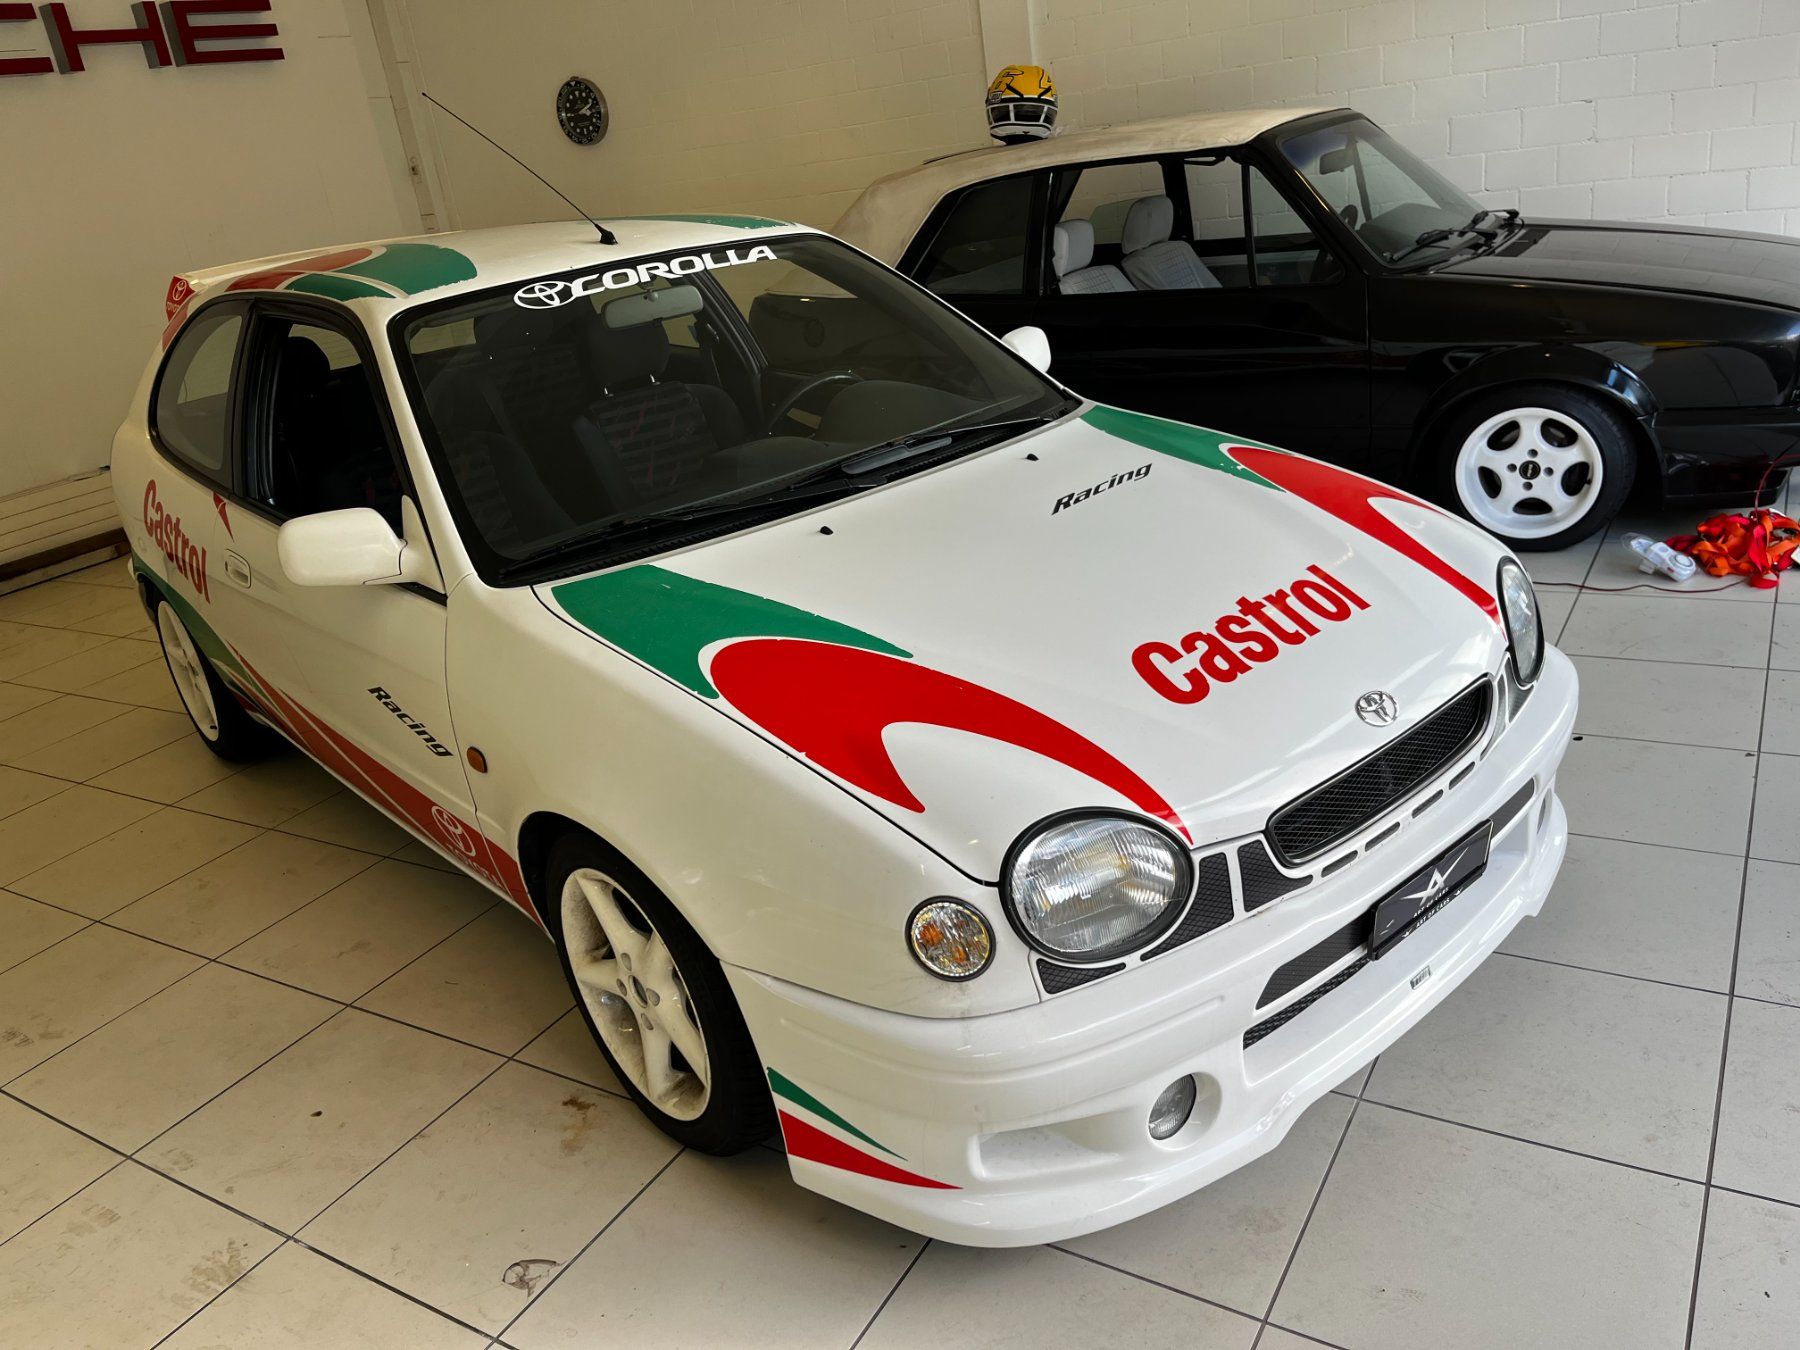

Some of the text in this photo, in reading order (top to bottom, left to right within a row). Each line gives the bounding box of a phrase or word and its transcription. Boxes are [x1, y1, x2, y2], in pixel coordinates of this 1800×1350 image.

[570, 245, 777, 298] COROLLA
[1051, 463, 1152, 516] Racing
[143, 479, 211, 605] Castrol
[1131, 564, 1372, 705] Castrol
[367, 686, 454, 756] Racing
